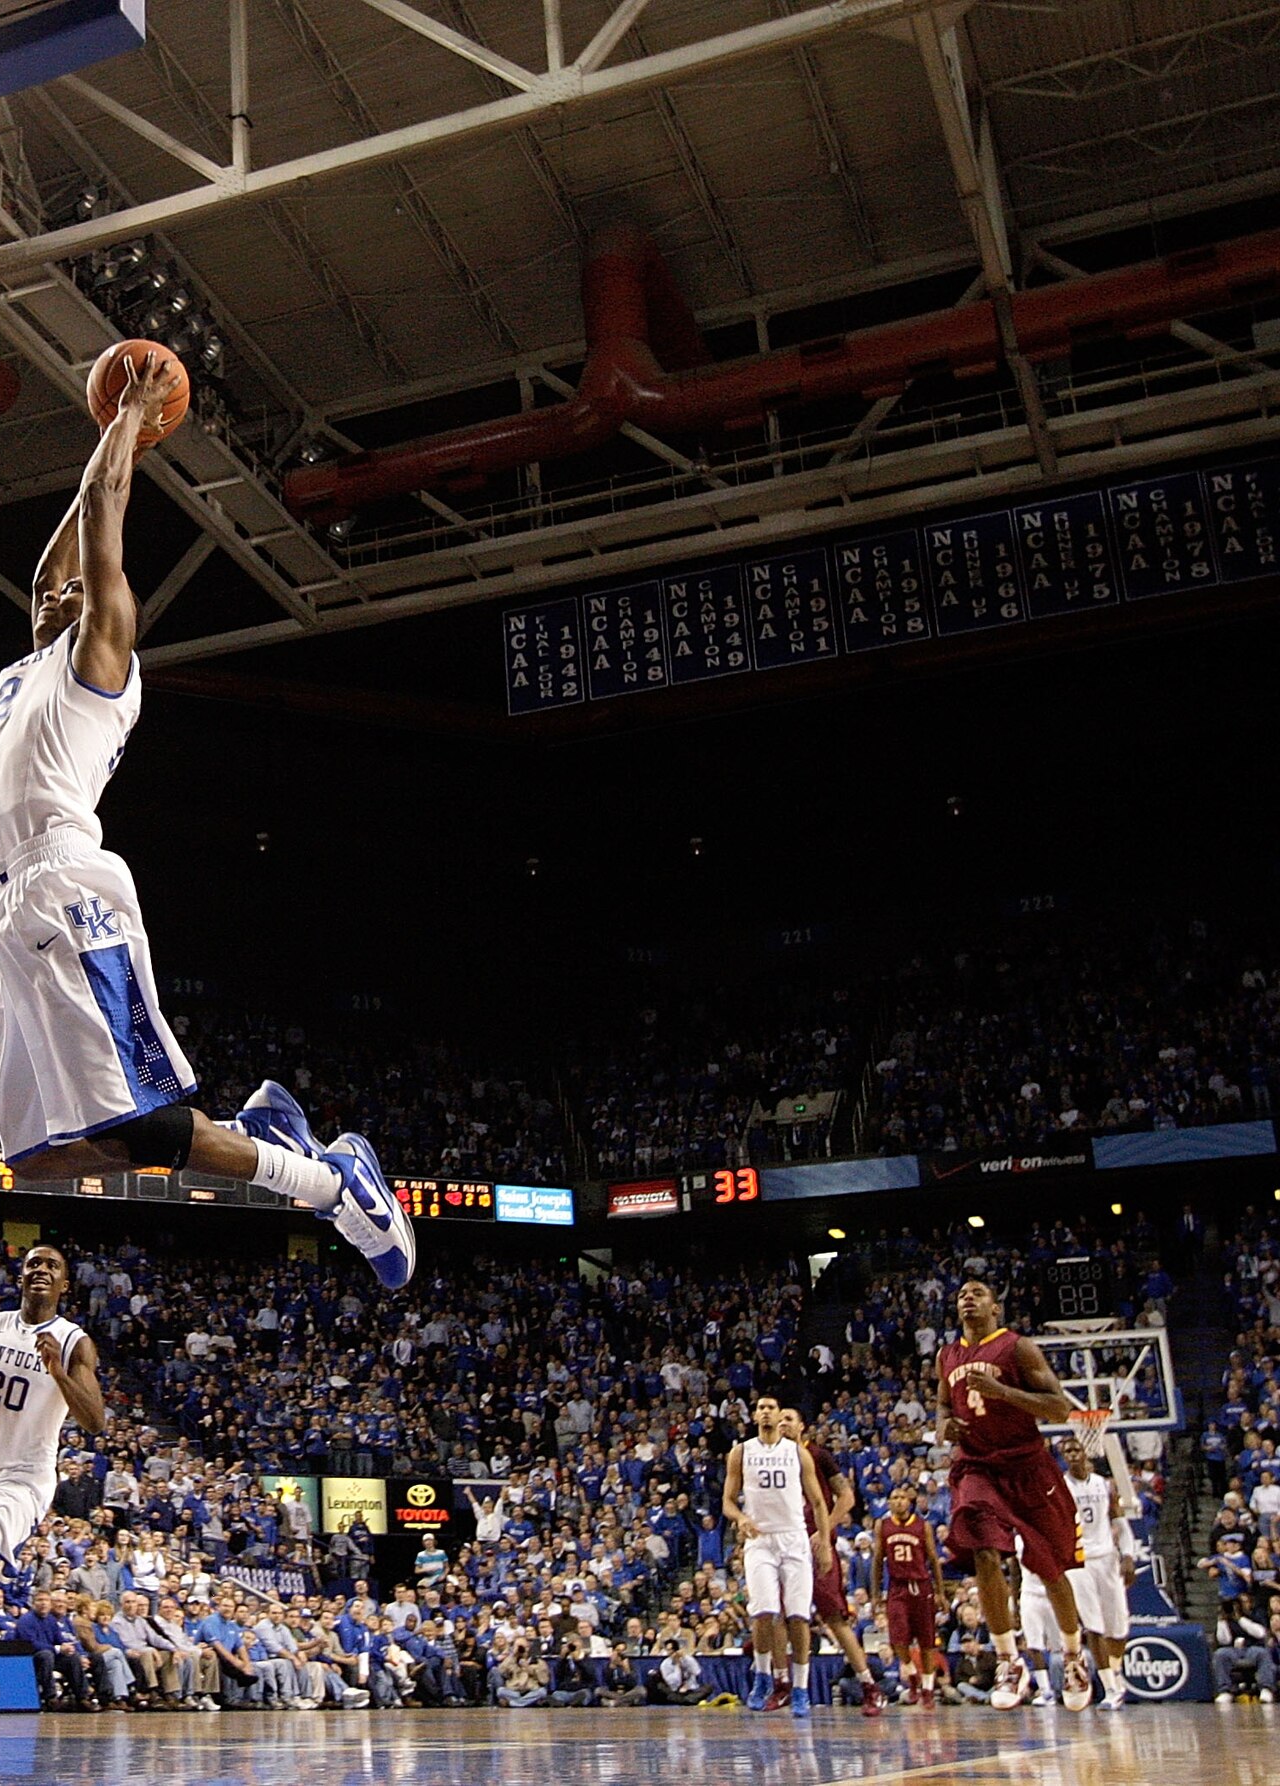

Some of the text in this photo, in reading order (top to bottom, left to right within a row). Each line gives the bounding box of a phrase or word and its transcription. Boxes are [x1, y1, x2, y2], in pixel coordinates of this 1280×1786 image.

[1116, 491, 1149, 571] NCAA
[1210, 473, 1244, 554] NCAA
[1244, 472, 1265, 519] FINAL
[931, 529, 960, 607] NCAA
[1021, 512, 1052, 590] NCAA
[1084, 521, 1111, 600] 1975
[1148, 488, 1181, 583] CHAMPION
[1182, 499, 1211, 579] 1978
[752, 565, 778, 640] NCAA
[781, 564, 806, 654] CHAMPION
[809, 578, 832, 653] 1951
[841, 547, 869, 624] NCAA
[871, 545, 897, 636] CHAMPION
[900, 559, 925, 634] 1958
[994, 542, 1019, 619] 1966
[509, 614, 530, 688] NCAA
[535, 615, 549, 658] FINAL
[588, 596, 610, 671] NCAA
[616, 596, 638, 684] CHAMPION
[642, 609, 664, 682] 1948
[668, 582, 693, 658] NCAA
[698, 580, 721, 668] CHAMPION
[722, 594, 745, 667] 1949
[559, 625, 578, 697] 1942
[64, 896, 121, 942] UK
[497, 1189, 571, 1210] Saint Joseph
[629, 1191, 673, 1205] TOYOTA
[713, 1167, 759, 1203] 33
[966, 1389, 986, 1417] 4
[747, 1456, 794, 1467] KENTUCKY
[758, 1470, 786, 1489] 30
[328, 1496, 382, 1513] Lexington
[395, 1508, 449, 1521] TOYOTA
[1083, 1507, 1094, 1524] 3
[893, 1544, 913, 1562] 21
[1123, 1647, 1181, 1689] Kroger
